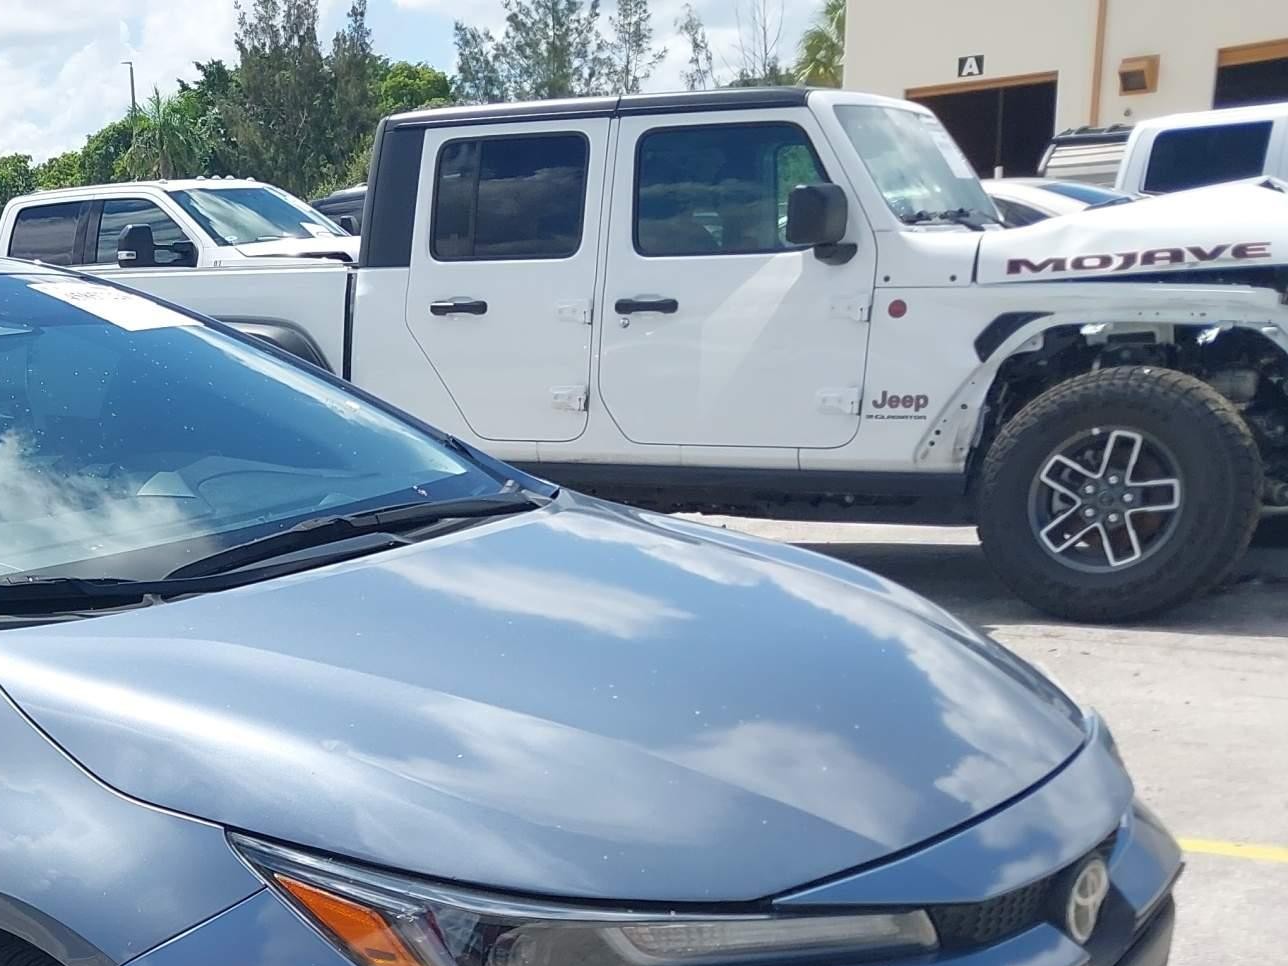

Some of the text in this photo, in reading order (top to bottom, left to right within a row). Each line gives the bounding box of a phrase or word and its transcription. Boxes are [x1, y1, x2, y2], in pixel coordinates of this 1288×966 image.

[961, 56, 980, 76] A
[1006, 241, 1272, 275] MOJAVE
[872, 390, 929, 412] Jeep
